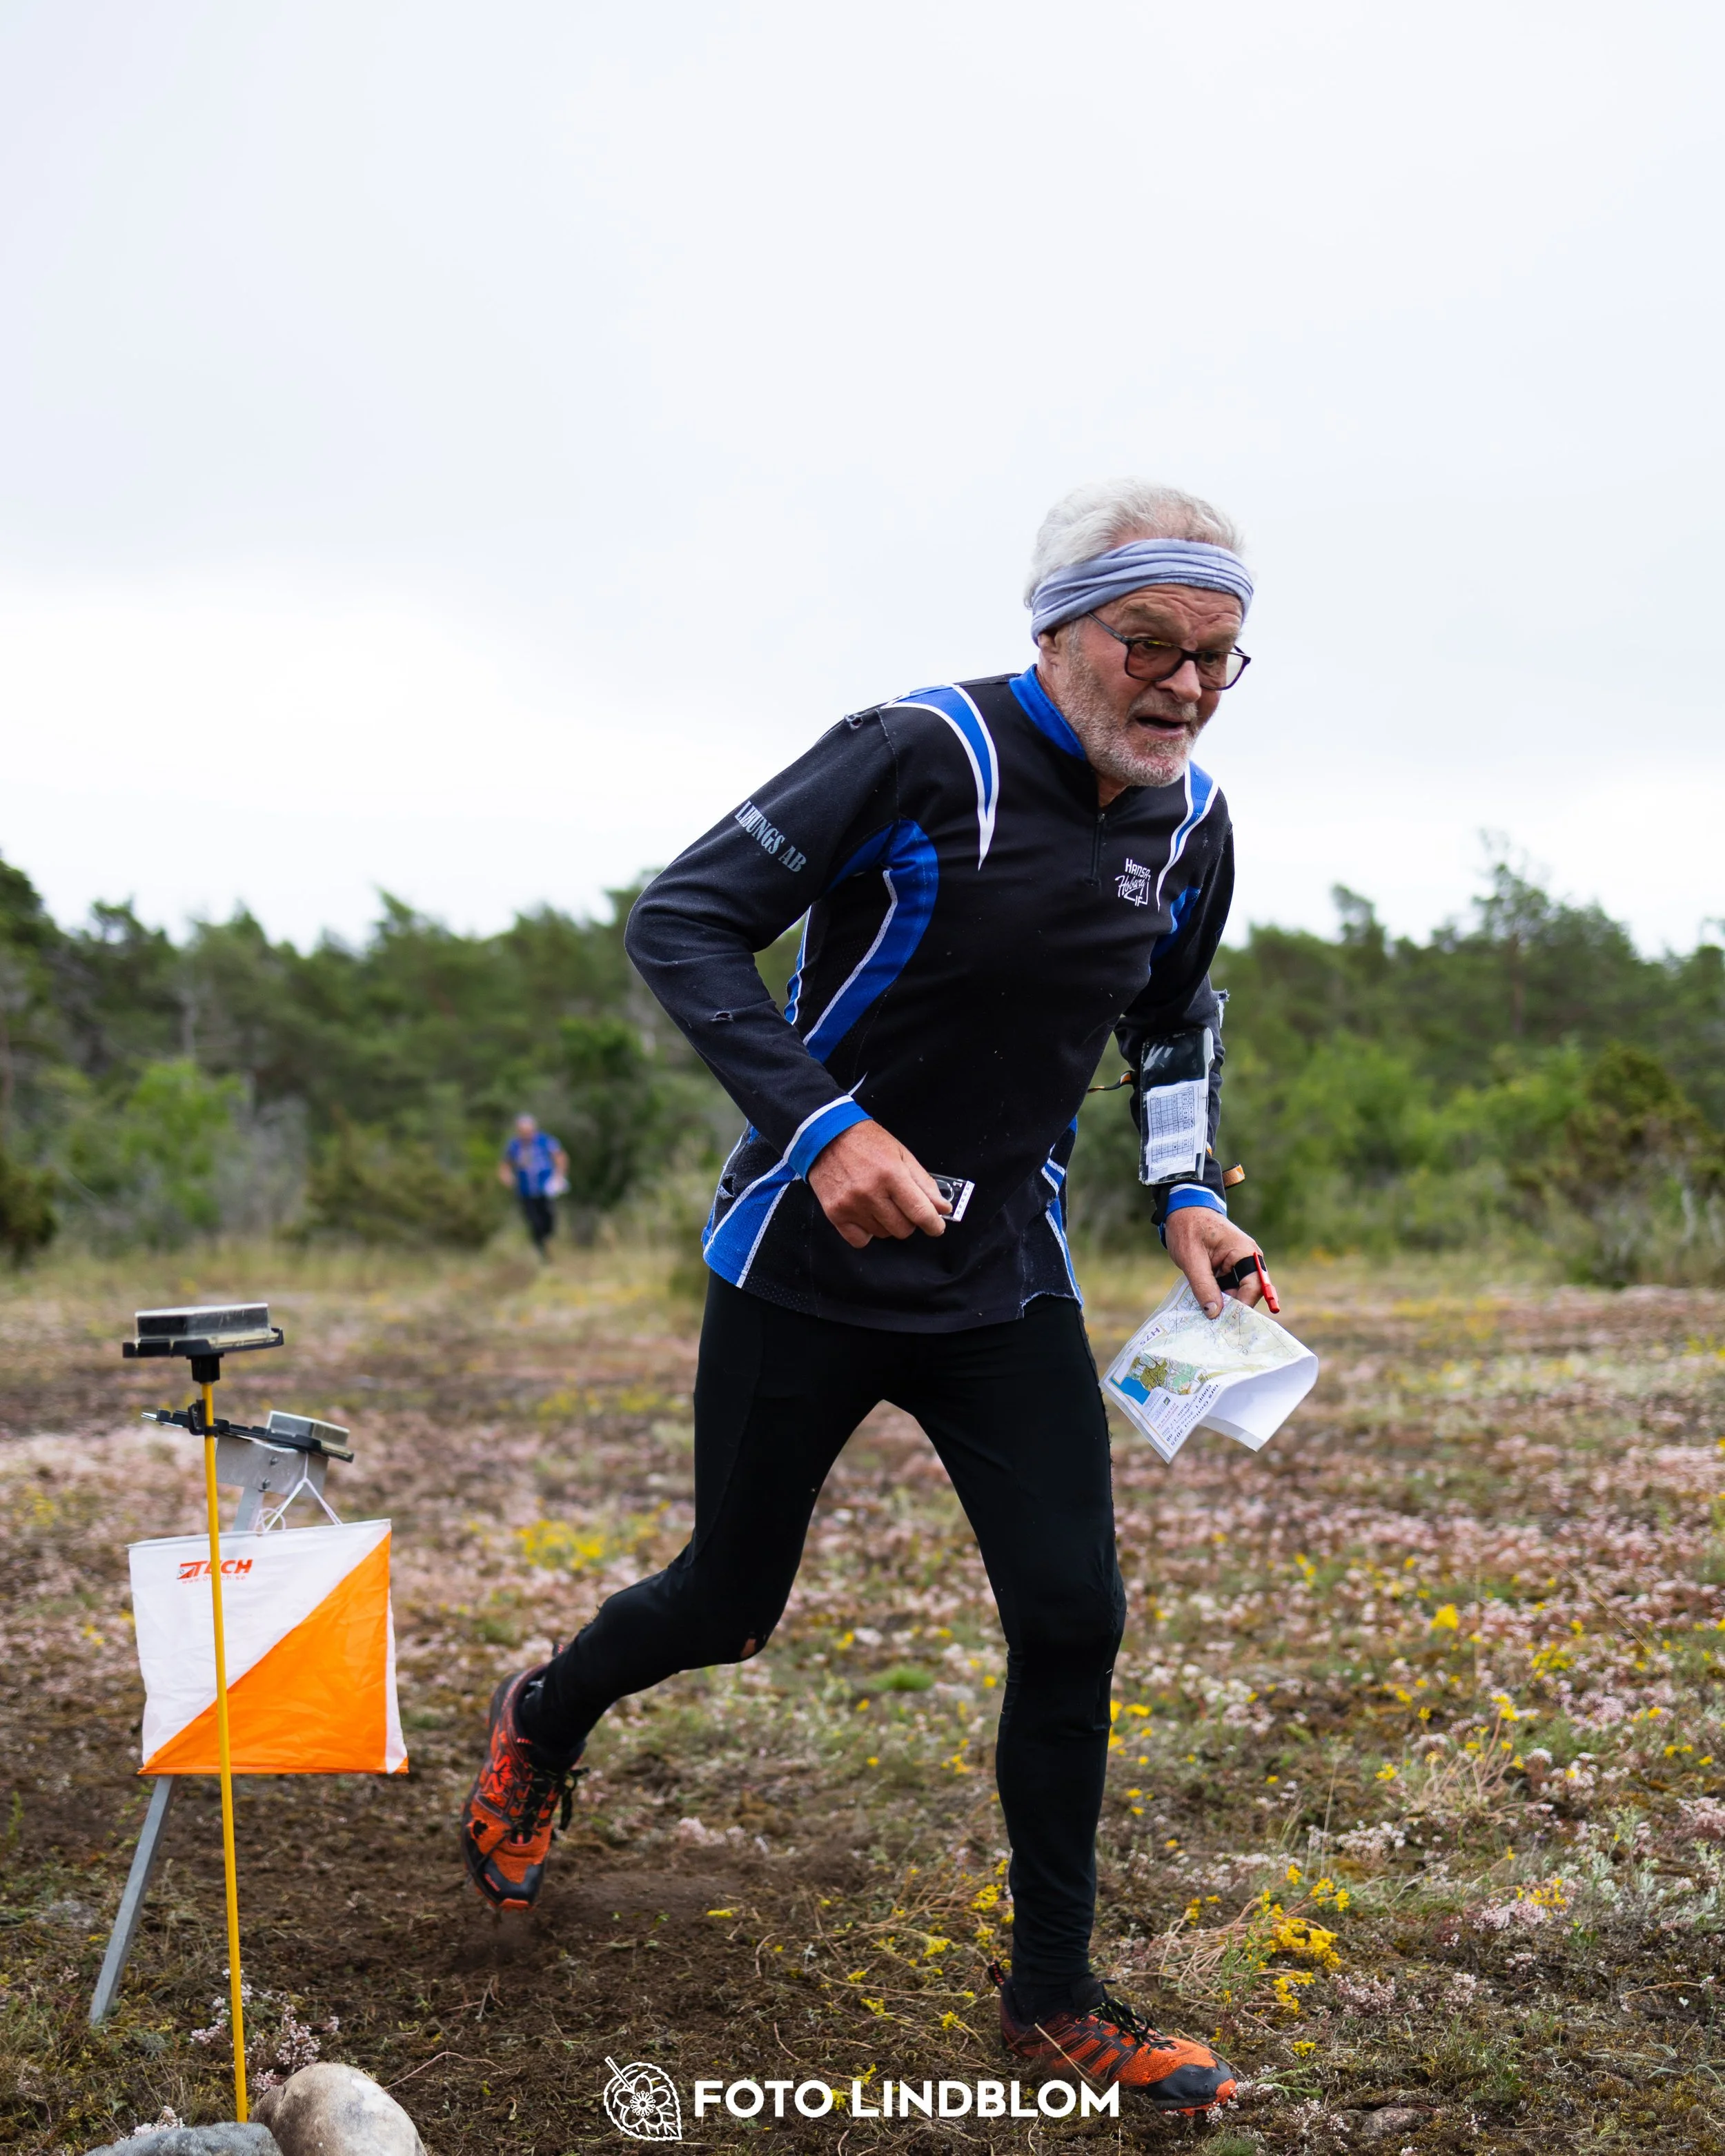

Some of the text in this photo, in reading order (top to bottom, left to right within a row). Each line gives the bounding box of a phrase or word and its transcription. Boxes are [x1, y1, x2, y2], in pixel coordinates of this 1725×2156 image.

[778, 846, 807, 872] AB
[1134, 895, 1143, 907] IF
[179, 1559, 253, 1579] TCH
